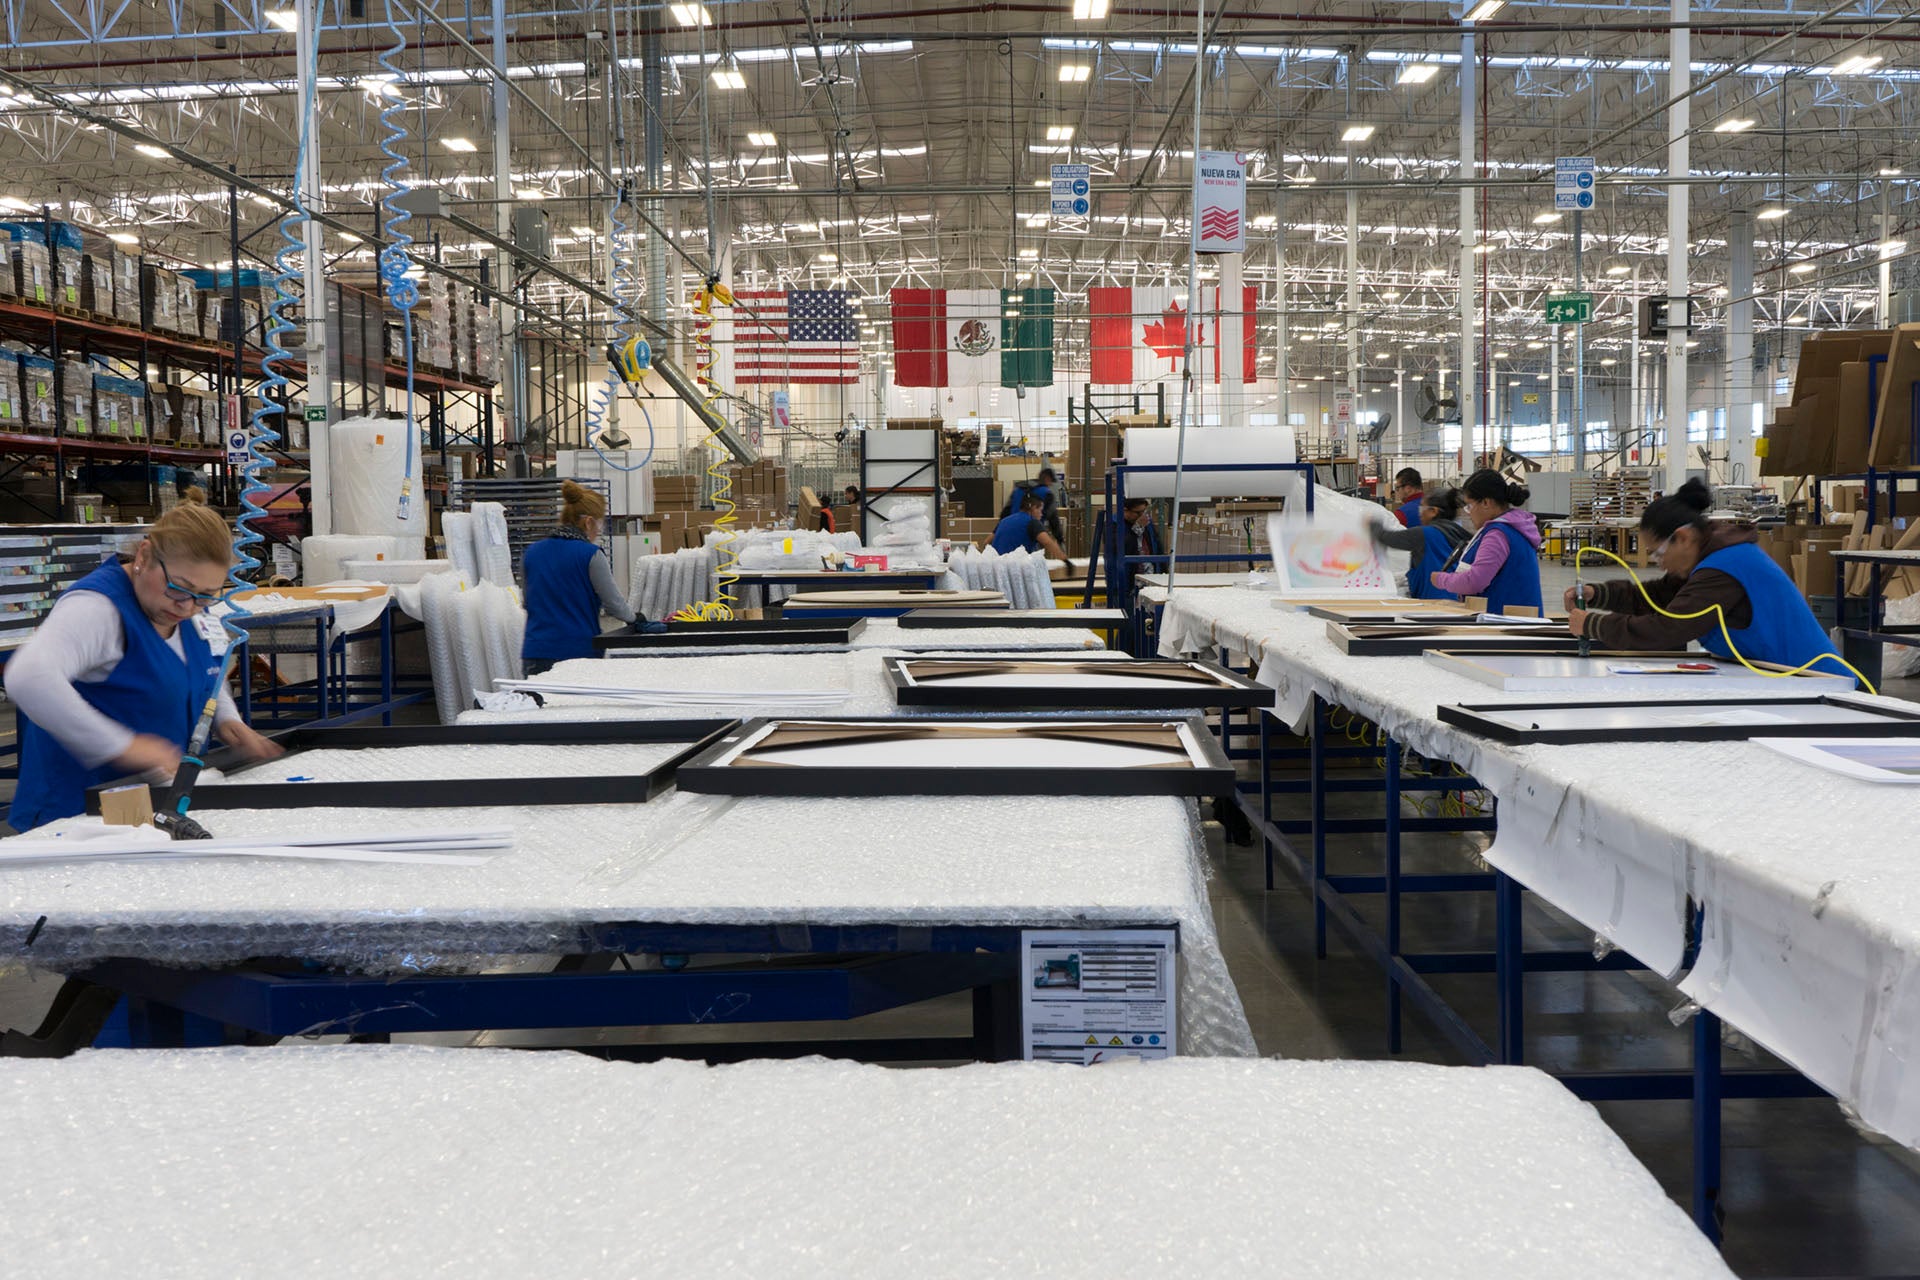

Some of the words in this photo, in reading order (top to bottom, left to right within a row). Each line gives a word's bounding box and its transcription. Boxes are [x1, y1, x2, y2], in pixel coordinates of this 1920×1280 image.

[1062, 166, 1088, 174] OBLIGATORIO
[1201, 168, 1225, 178] NUEVA
[1226, 169, 1241, 179] ERA
